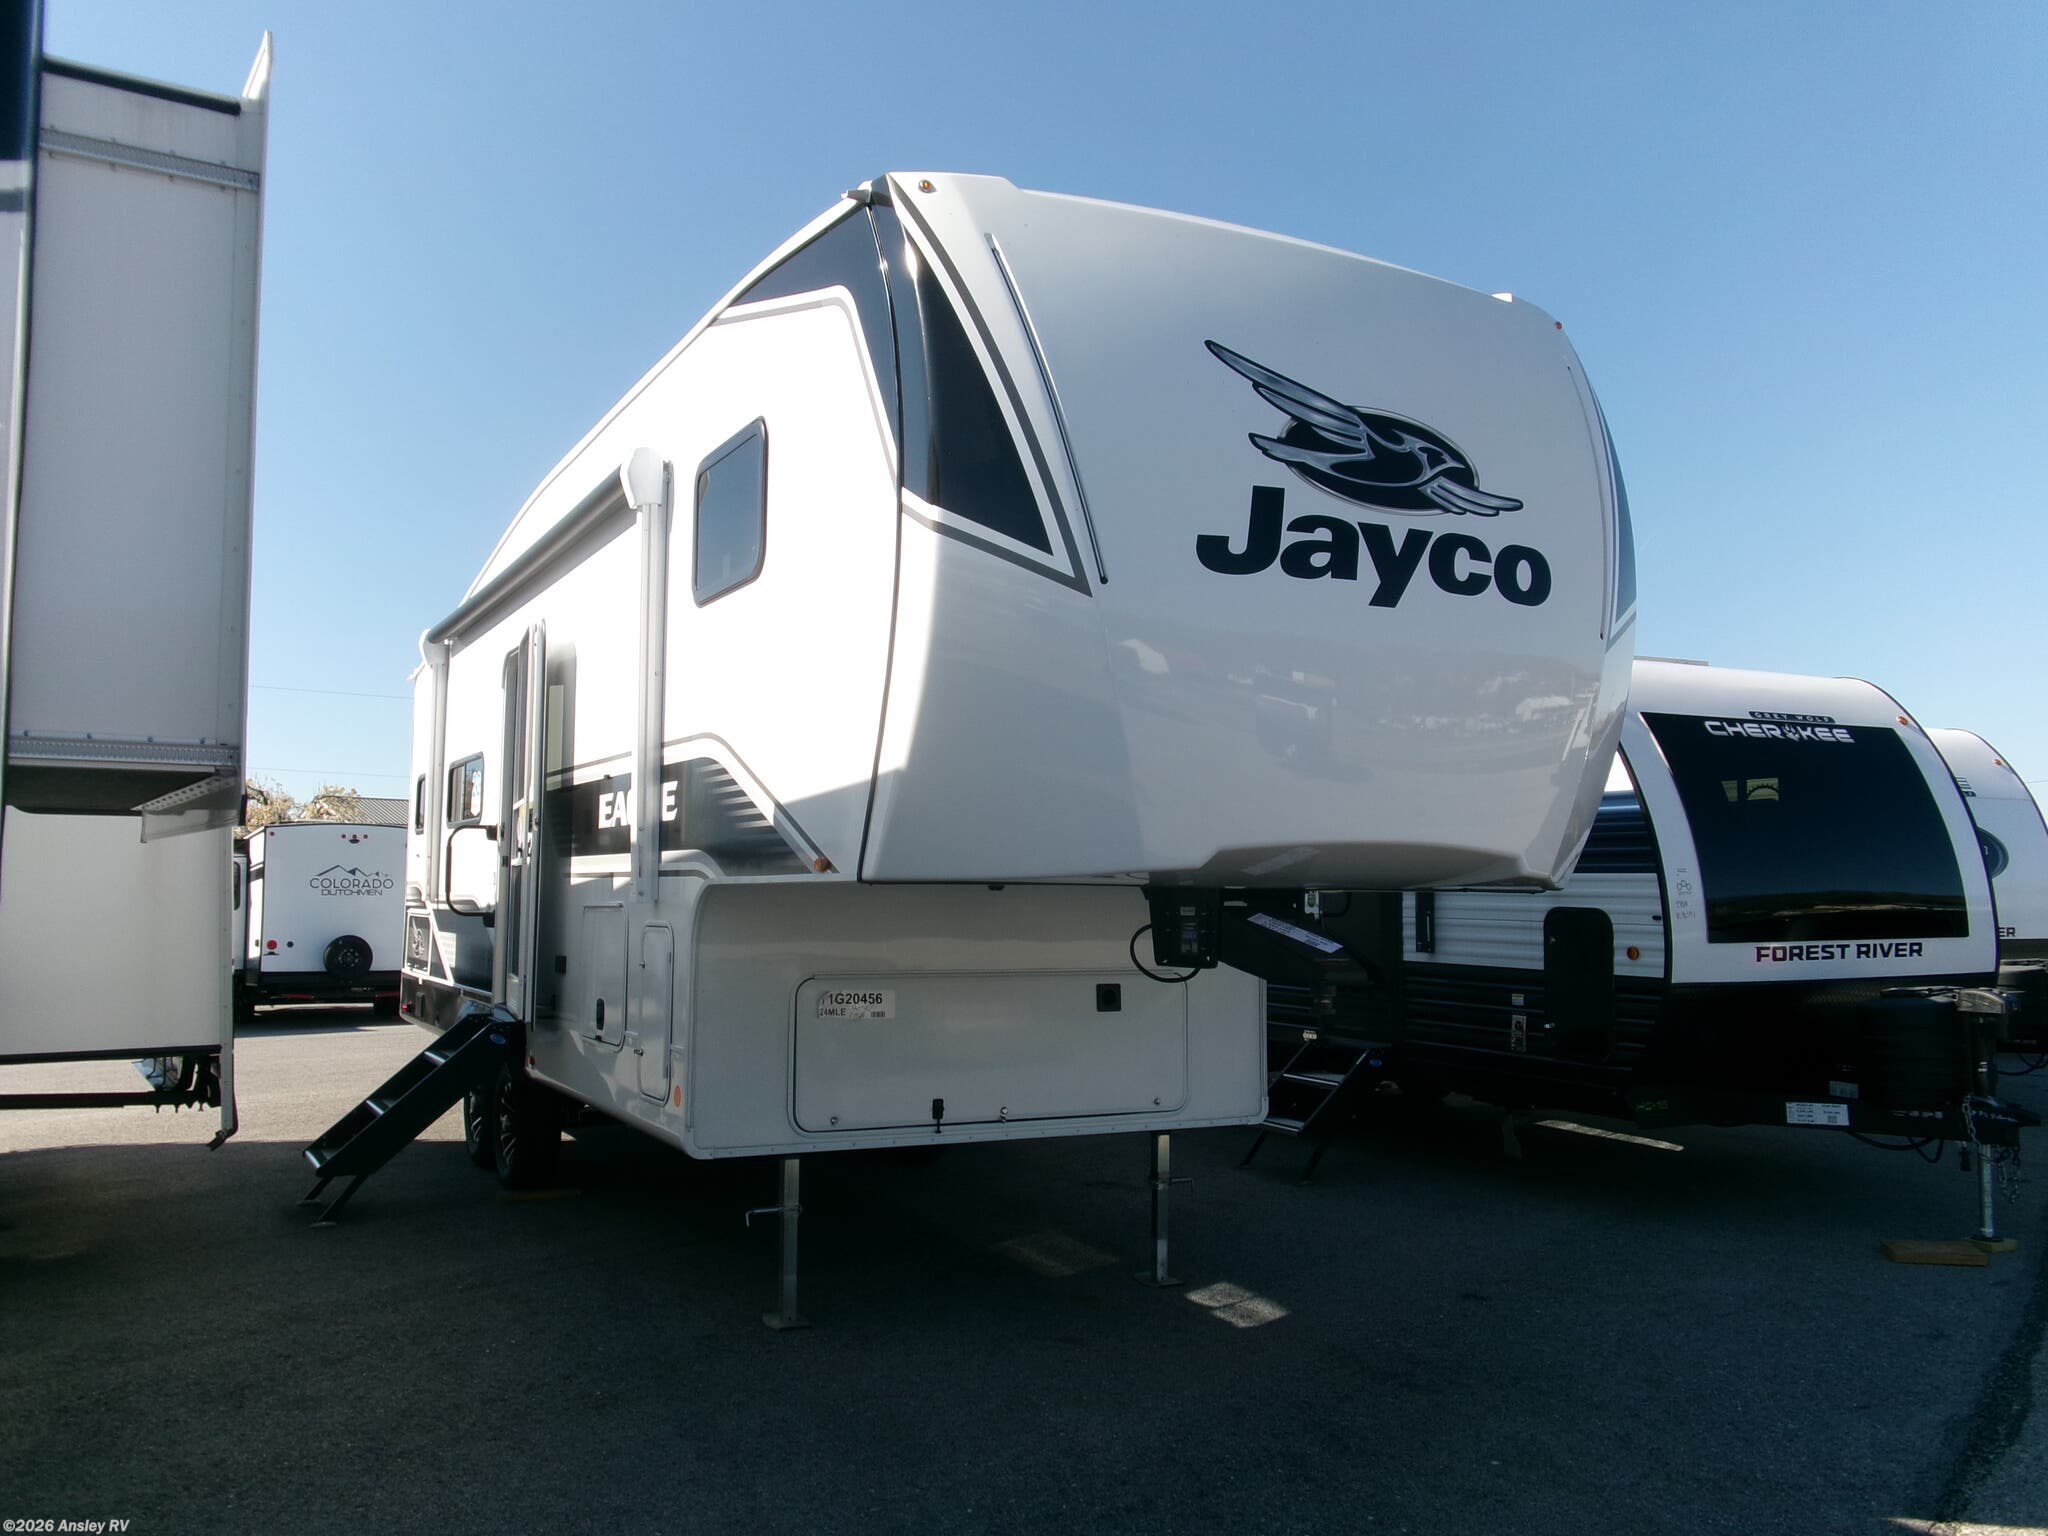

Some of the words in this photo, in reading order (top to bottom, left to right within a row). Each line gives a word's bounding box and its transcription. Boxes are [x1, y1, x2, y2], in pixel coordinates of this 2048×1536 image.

[1195, 485, 1552, 608] Jayco
[1754, 712, 1788, 720] GREY
[1794, 714, 1829, 722] WOLF
[598, 780, 678, 828] EAE
[310, 878, 394, 889] COLORADO
[1755, 944, 1850, 962] FOREST
[1856, 942, 1923, 959] RIVER
